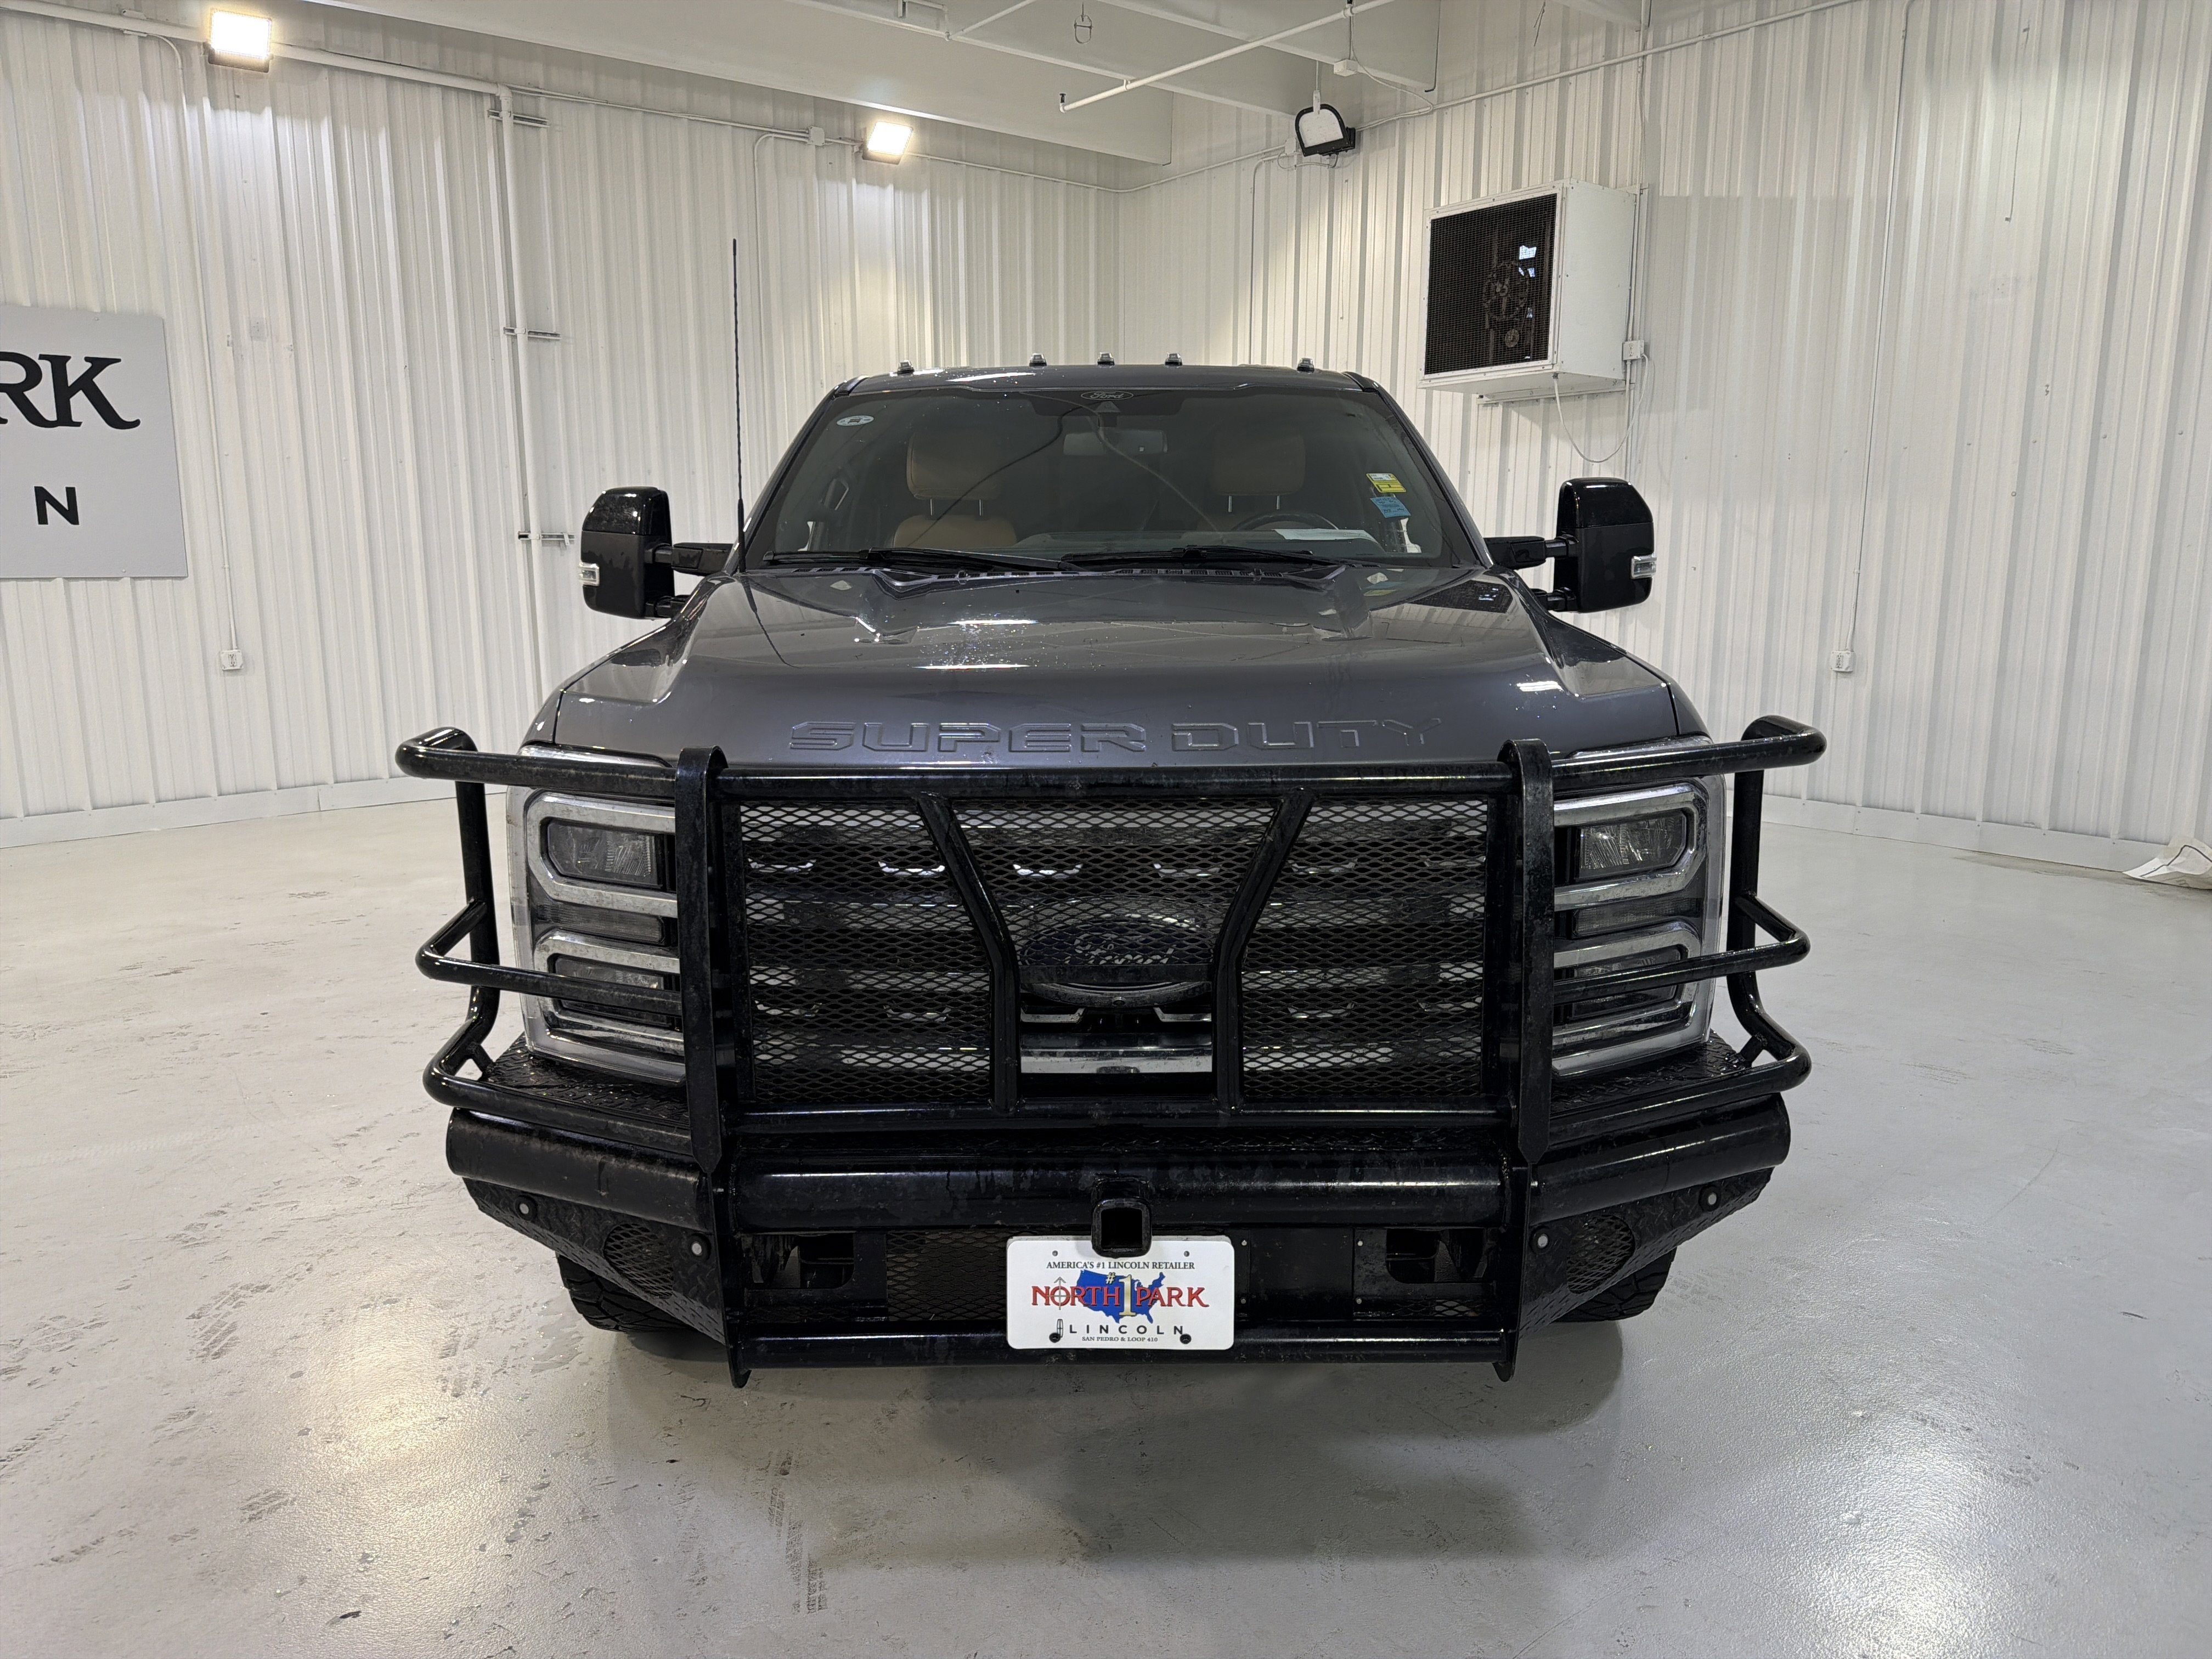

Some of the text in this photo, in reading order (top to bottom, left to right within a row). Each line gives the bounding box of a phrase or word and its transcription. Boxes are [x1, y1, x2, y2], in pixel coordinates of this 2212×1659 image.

[34, 486, 79, 525] N
[790, 718, 1441, 752] SUPER DUTY
[1031, 1285, 1210, 1307] NORTH PARK
[1069, 1324, 1183, 1335] LINCOLN
